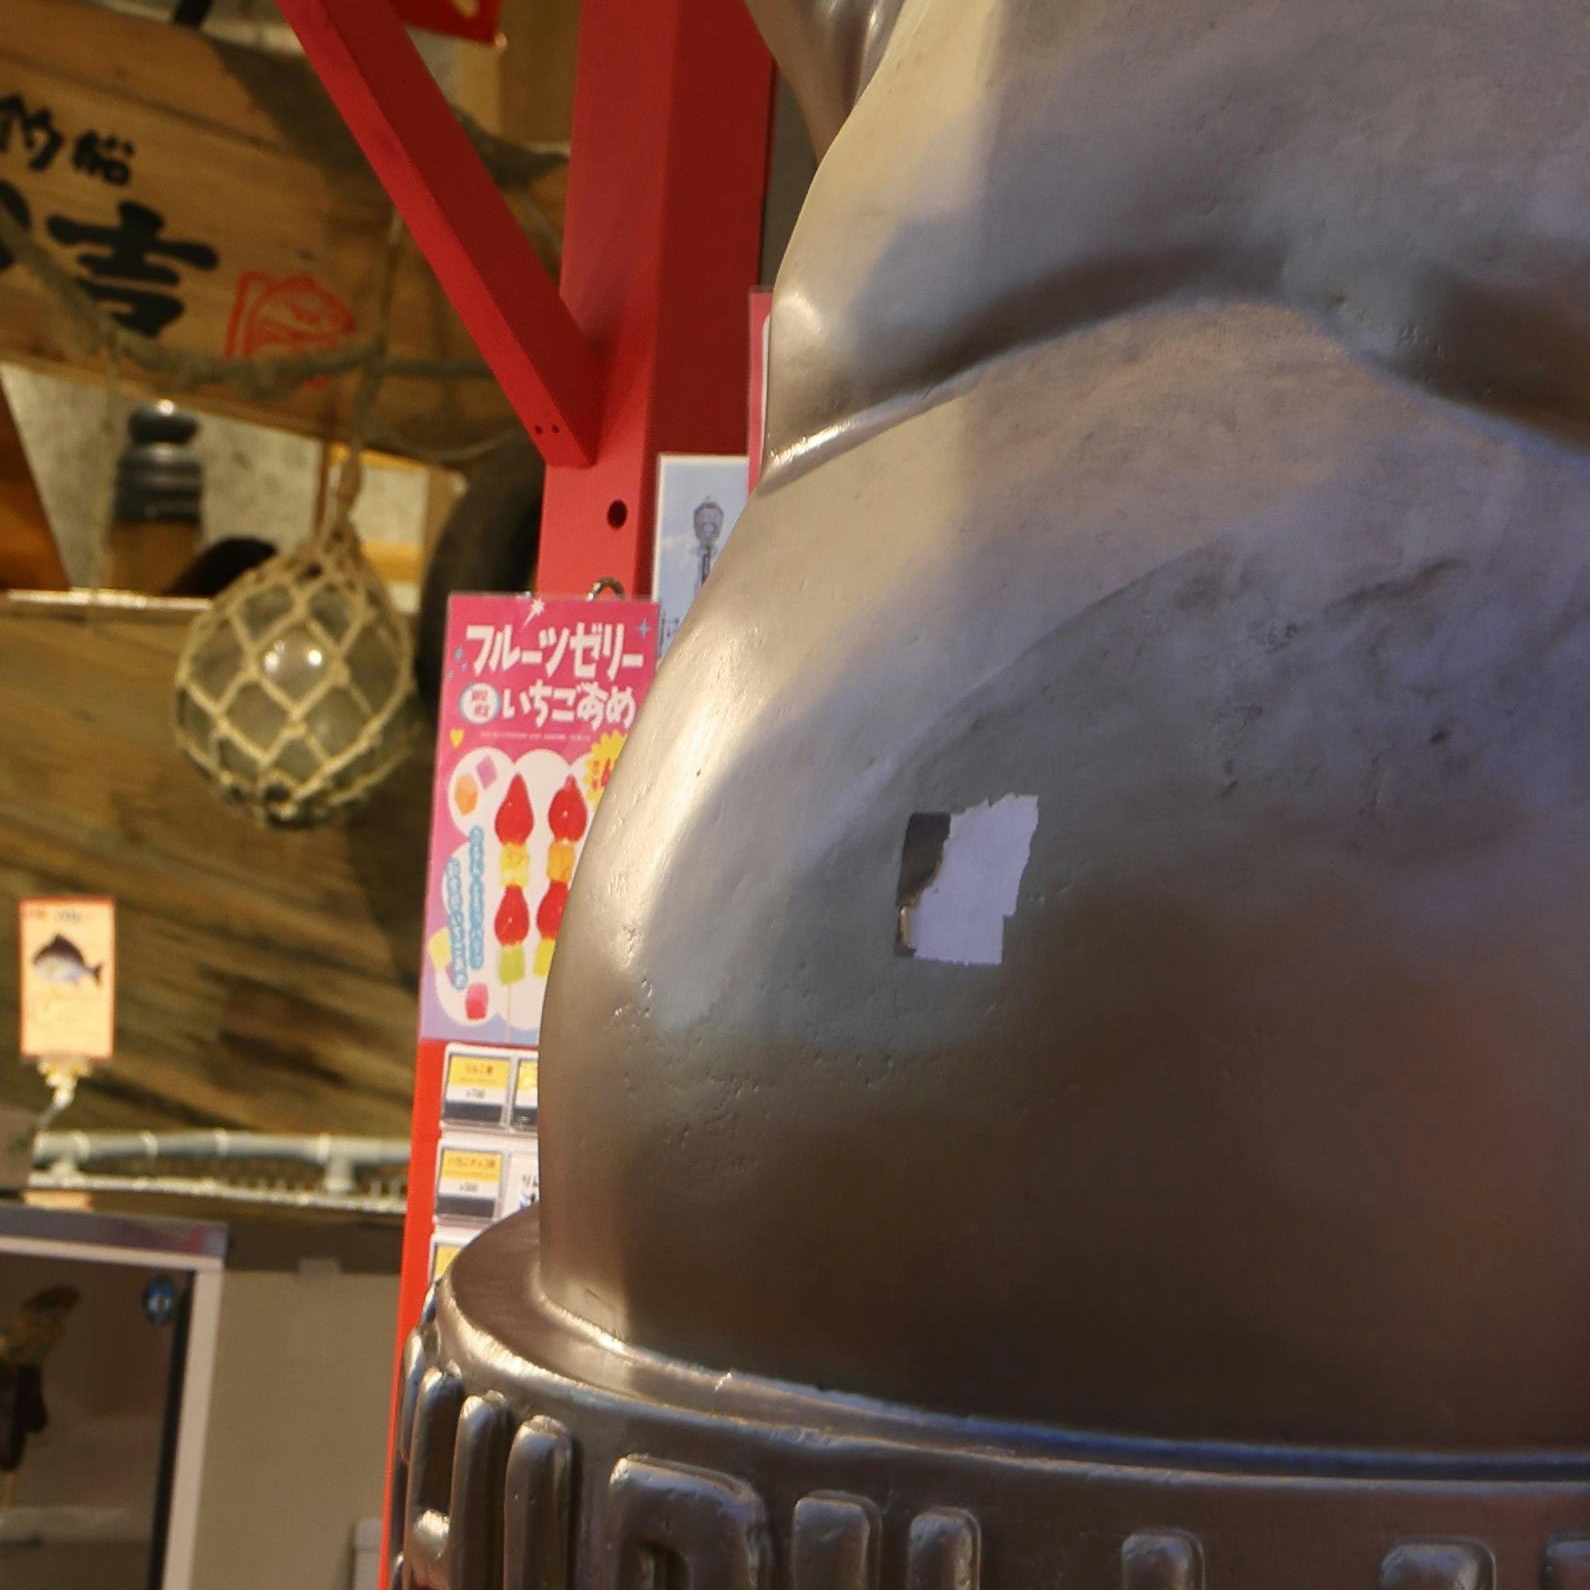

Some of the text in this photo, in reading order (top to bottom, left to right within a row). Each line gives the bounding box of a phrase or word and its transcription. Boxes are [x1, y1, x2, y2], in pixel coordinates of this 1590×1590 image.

[465, 622, 645, 681] フルーツゼリー
[502, 679, 637, 731] いちごあめ
